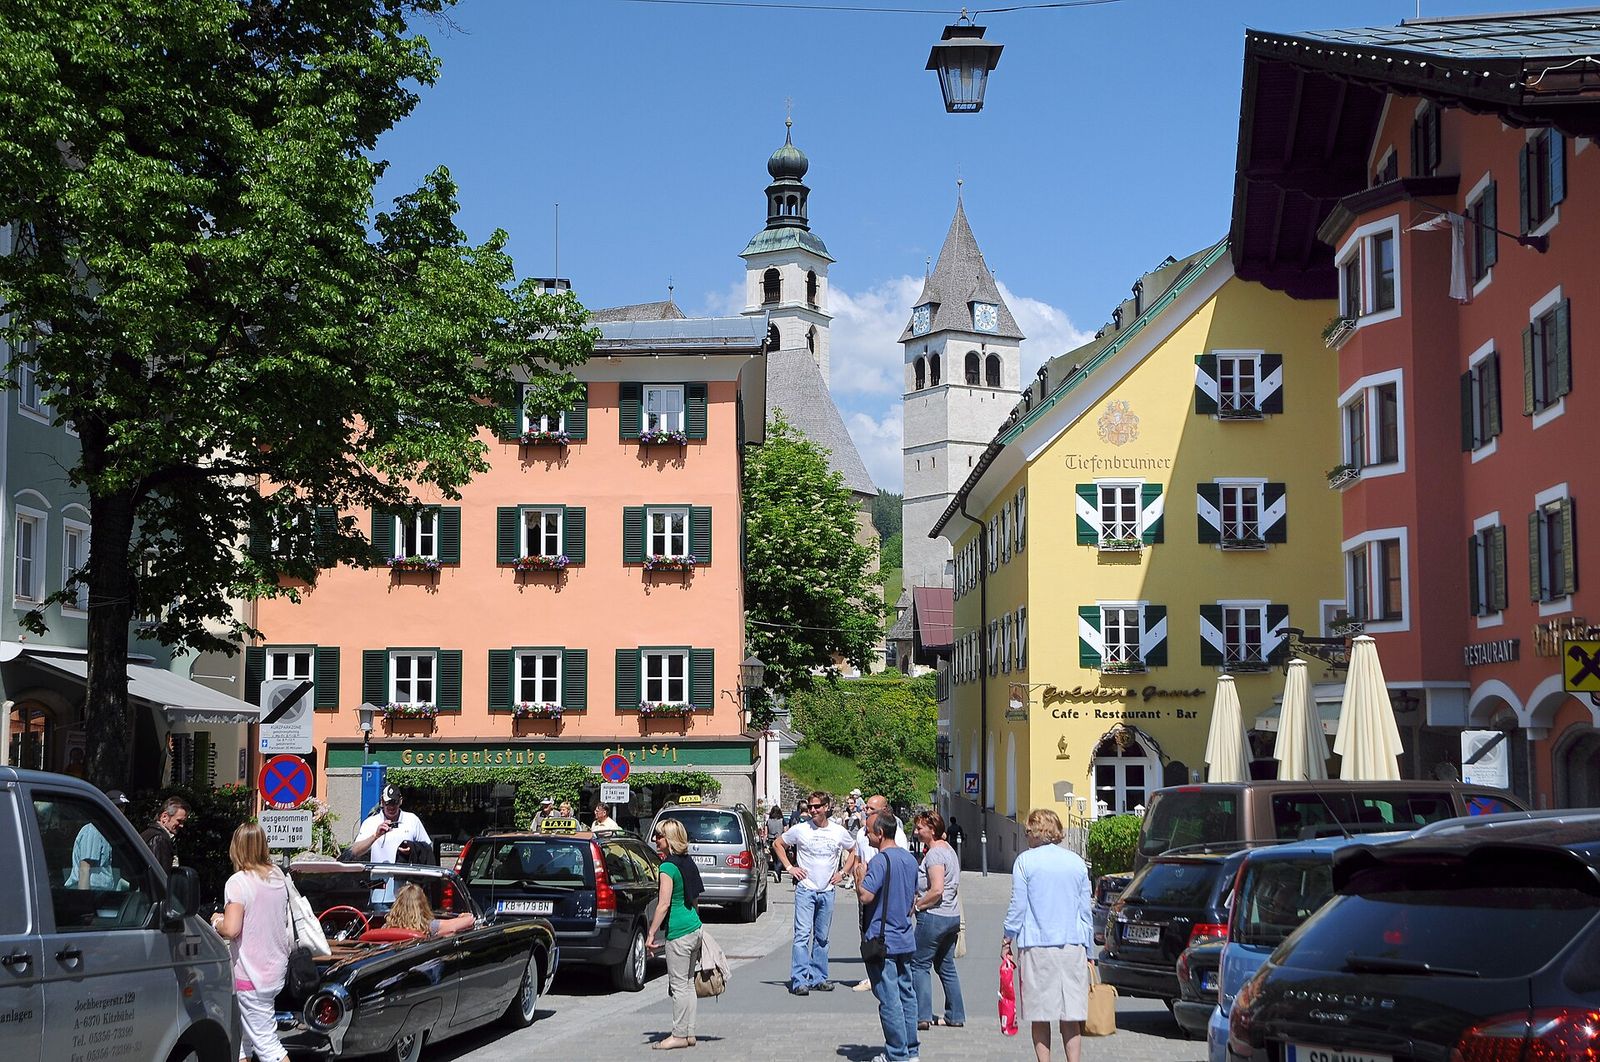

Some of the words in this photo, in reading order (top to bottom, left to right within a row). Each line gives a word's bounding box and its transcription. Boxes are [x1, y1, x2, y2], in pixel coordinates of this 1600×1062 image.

[1065, 454, 1171, 473] Tiefenbrunner
[1464, 639, 1513, 666] RESTAURANT
[1051, 709, 1080, 719] Cafe
[1094, 709, 1161, 719] Restaurant
[1176, 709, 1198, 719] Bar
[401, 748, 546, 765] Geschenkstube
[366, 771, 373, 782] P
[262, 815, 309, 824] ausgenommen
[267, 825, 272, 833] 3
[274, 825, 289, 833] TAXI
[1283, 989, 1396, 1009] PORSCHE
[103, 1008, 135, 1025] Kitzbühel
[72, 1035, 87, 1048] Tel.
